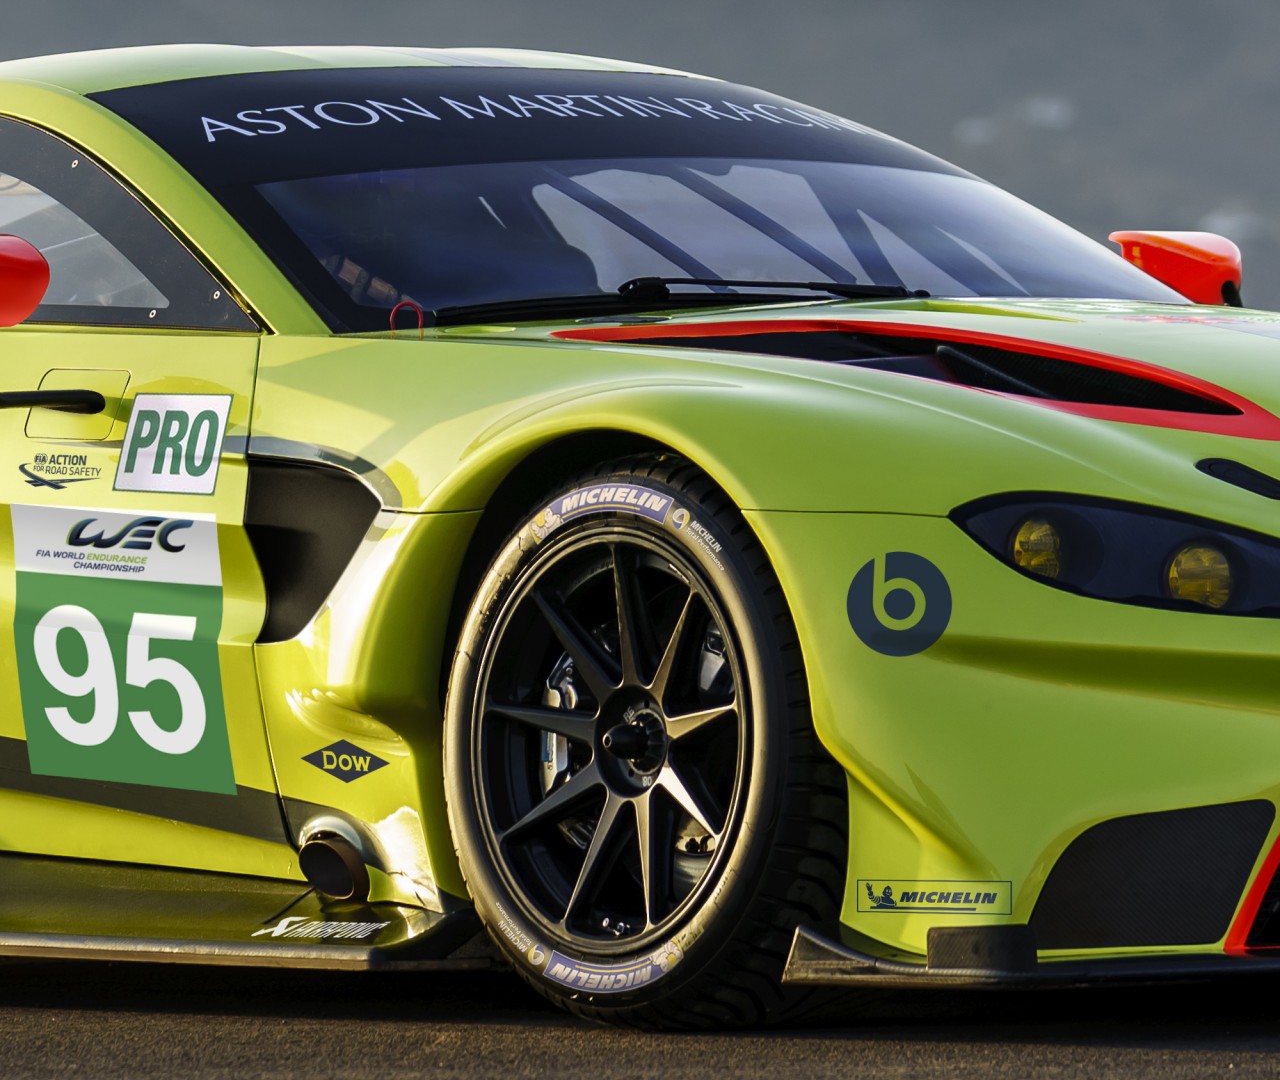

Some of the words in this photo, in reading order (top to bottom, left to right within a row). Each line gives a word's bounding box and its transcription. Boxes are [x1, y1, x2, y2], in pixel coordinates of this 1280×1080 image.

[200, 97, 442, 142] ASTON
[439, 93, 692, 120] MARTIN
[123, 410, 220, 477] PRO
[44, 465, 68, 475] ROAD
[69, 466, 102, 477] SAFETY
[48, 454, 88, 466] ACTION
[561, 487, 668, 514] MICHELIN
[65, 516, 195, 553] WEC
[690, 520, 723, 553] MICHELIN
[36, 549, 51, 558] FIA
[53, 550, 86, 560] WORLD
[86, 552, 149, 565] ENDURANCE
[686, 527, 700, 541] Total
[697, 538, 725, 571] Performance
[73, 561, 146, 573] CHAMPIONSHIP
[33, 604, 207, 755] 95
[321, 749, 372, 772] DOW
[899, 891, 998, 904] MICHELIN
[497, 919, 528, 953] MICHELIN
[520, 932, 533, 946] Total
[549, 962, 653, 990] MICHELIN
